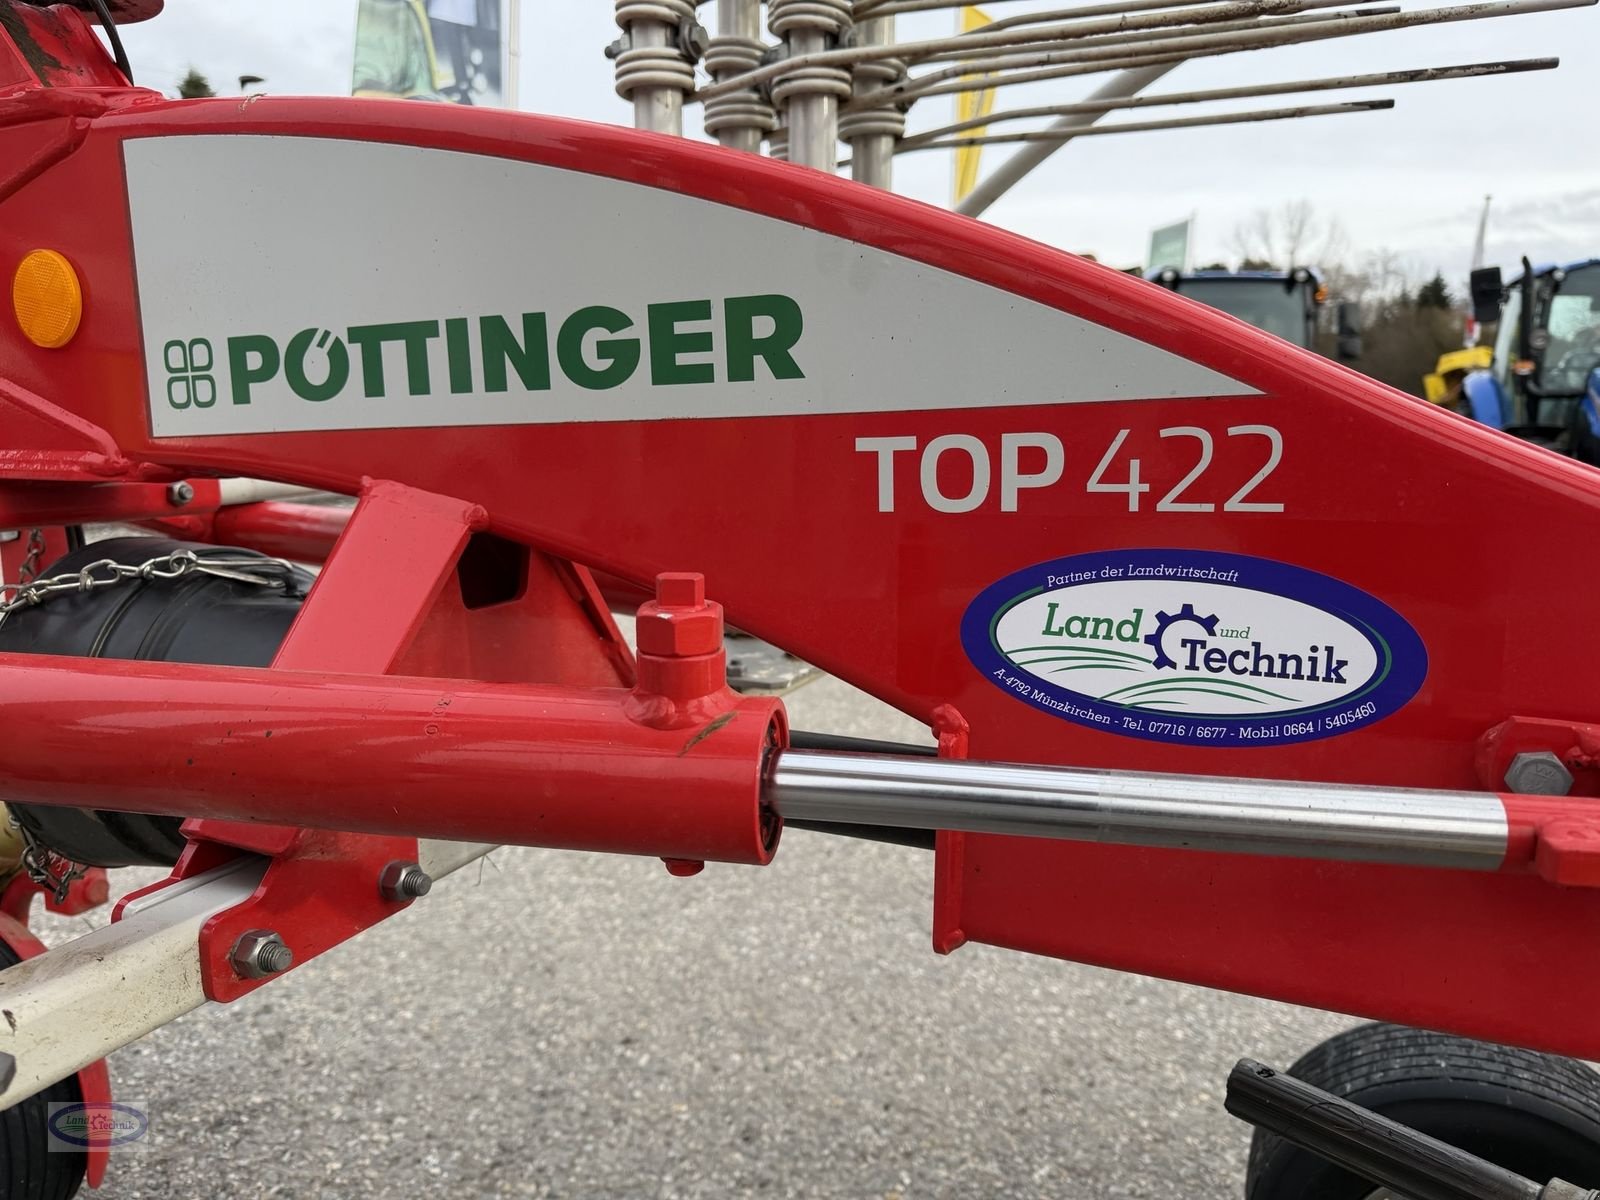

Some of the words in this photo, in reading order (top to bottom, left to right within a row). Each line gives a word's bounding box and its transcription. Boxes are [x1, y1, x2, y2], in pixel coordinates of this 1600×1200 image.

[227, 294, 806, 405] PÖTTINGER
[855, 432, 1065, 513] TOP
[1086, 424, 1285, 513] 422
[1047, 570, 1097, 588] Partner
[1100, 565, 1124, 578] der
[1127, 564, 1239, 583] Landwirtschaft
[1041, 602, 1144, 643] Land
[1219, 626, 1251, 640] und
[1180, 638, 1349, 685] Technik
[993, 668, 1031, 696] A-4792
[1030, 689, 1111, 725] Münzkirchen
[1122, 716, 1145, 731] Tel.
[1148, 721, 1186, 736] 07716
[1196, 726, 1227, 739] 6677
[1238, 725, 1280, 739] Mobil
[1283, 721, 1314, 737] 0664
[1325, 701, 1377, 730] 5405460
